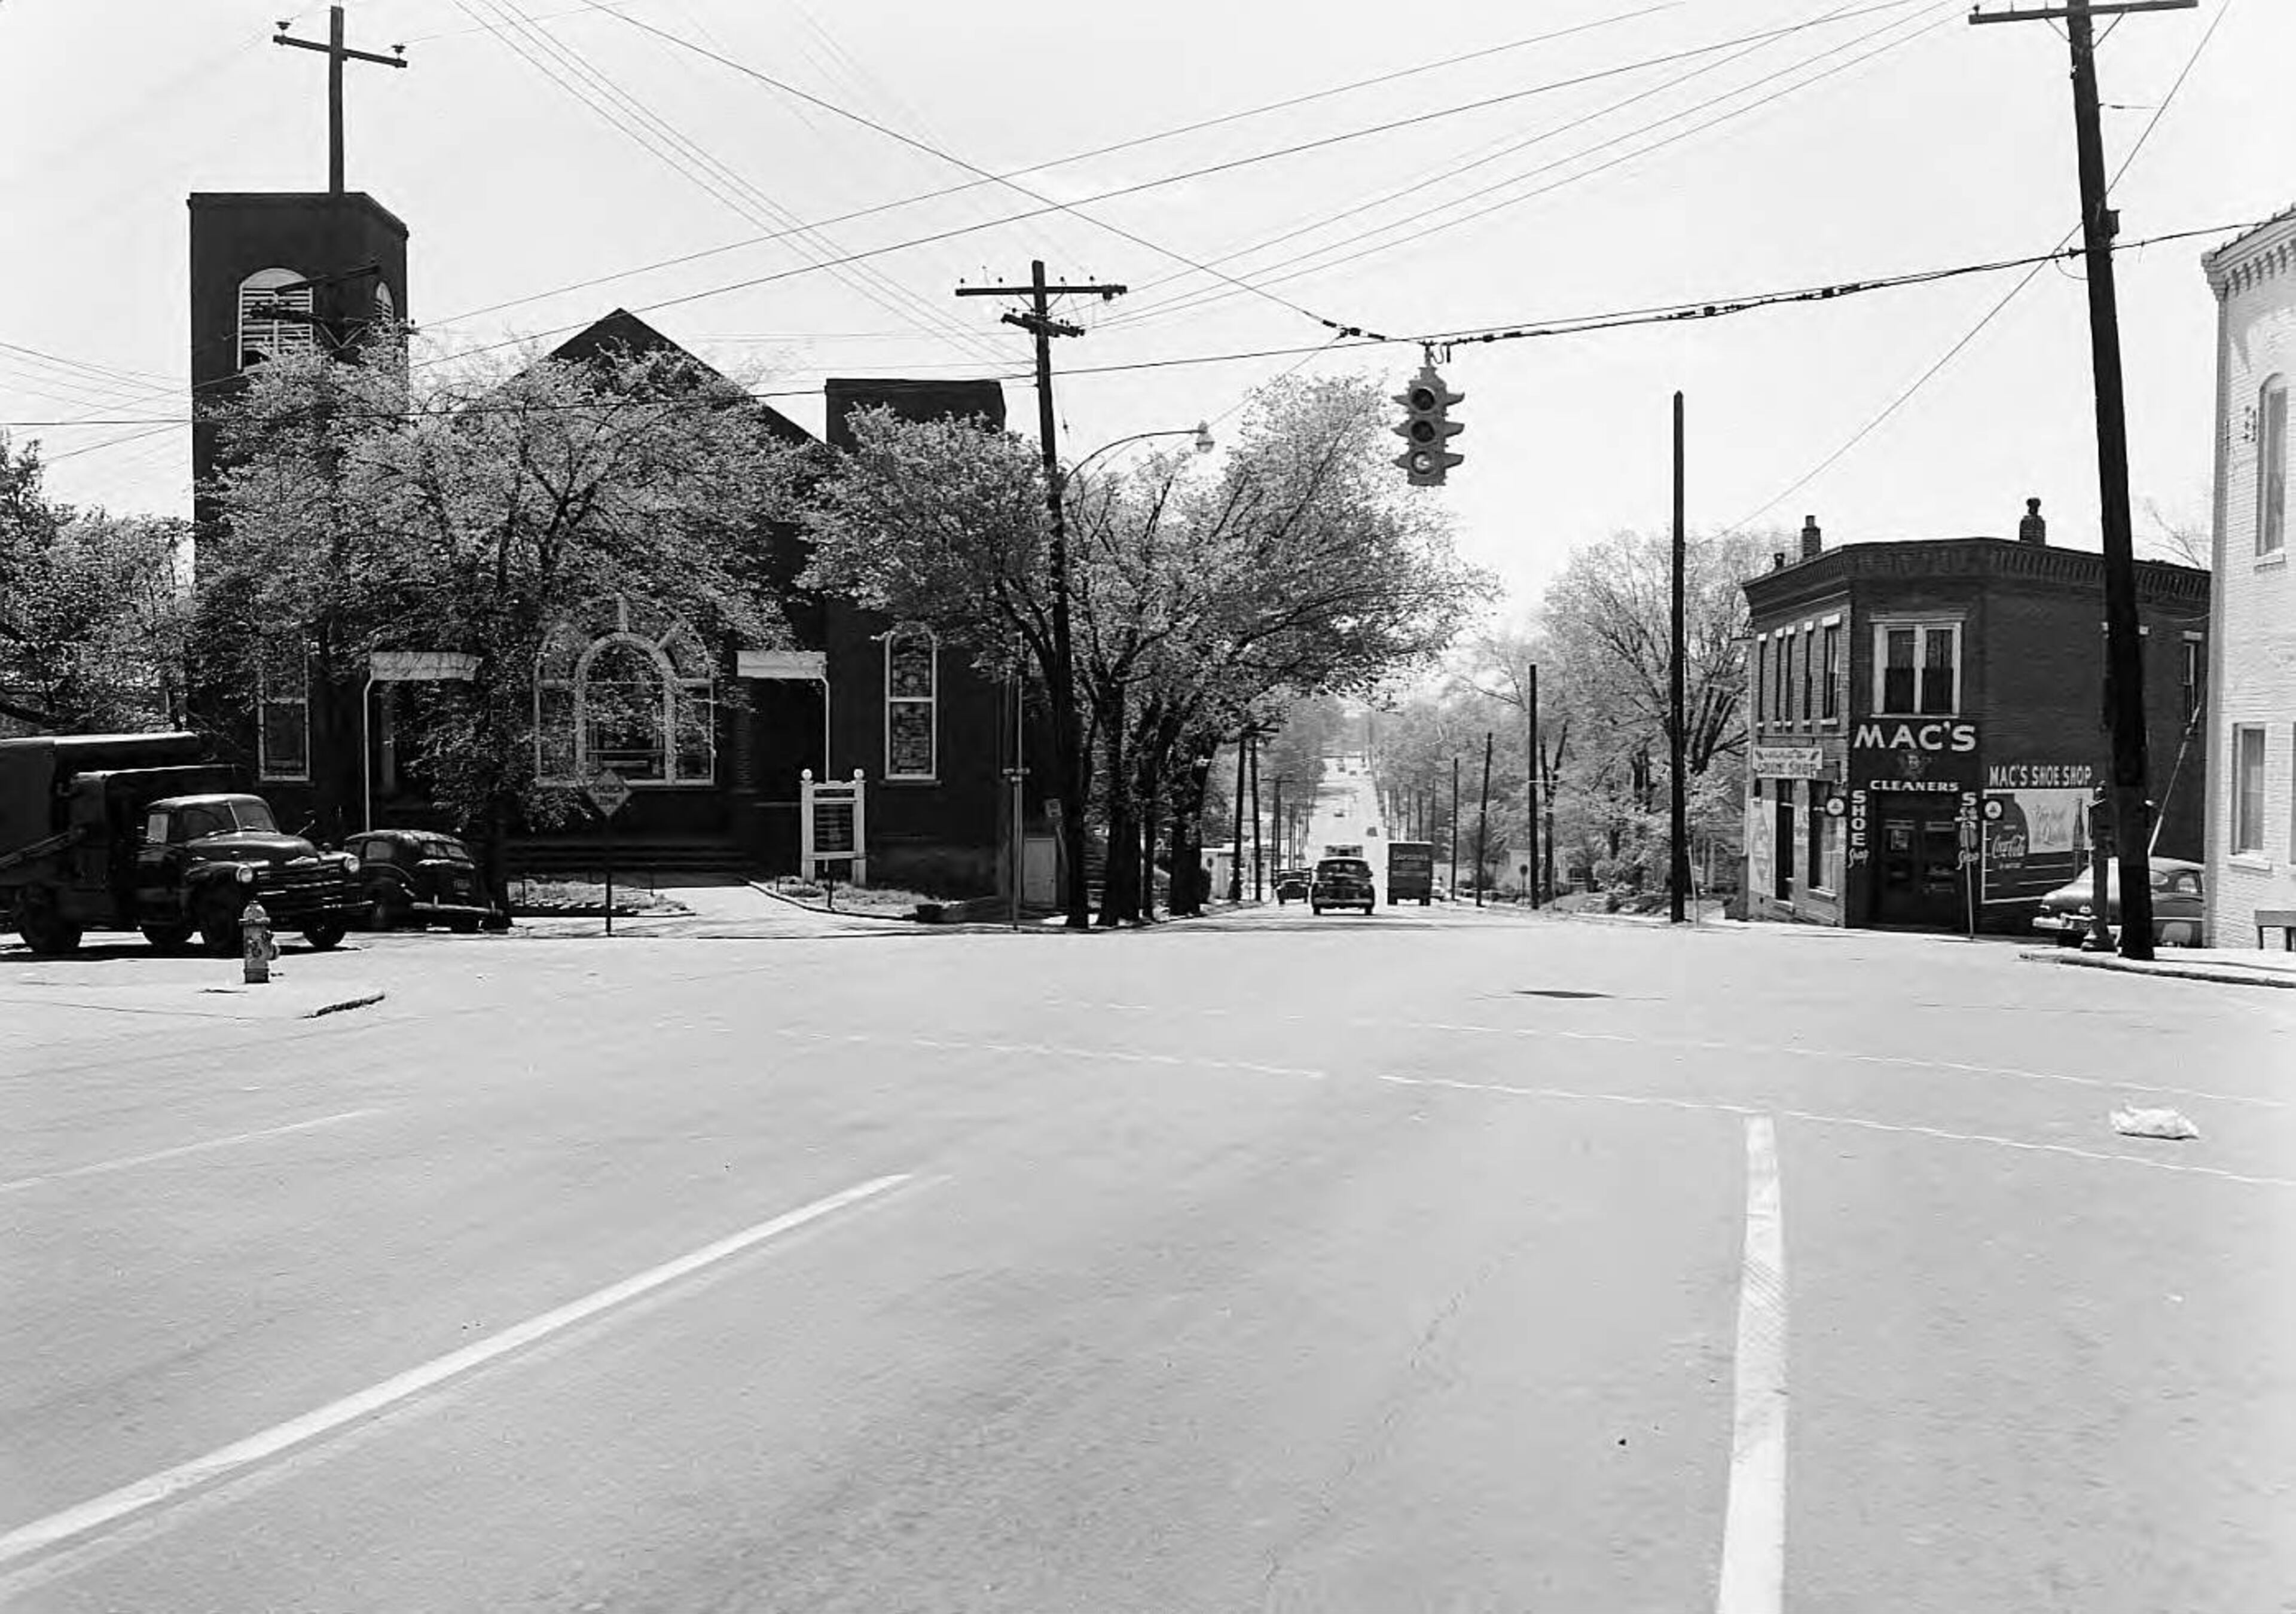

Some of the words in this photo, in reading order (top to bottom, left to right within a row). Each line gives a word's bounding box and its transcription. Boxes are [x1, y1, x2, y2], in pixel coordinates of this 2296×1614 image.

[1854, 721, 1976, 751] MAC'S
[1870, 780, 1959, 791] CLEANERS
[1989, 765, 2028, 787] MAC'S
[2032, 765, 2060, 787] SHOE
[2063, 765, 2092, 787] SHOP
[1851, 790, 1867, 846] SHOE
